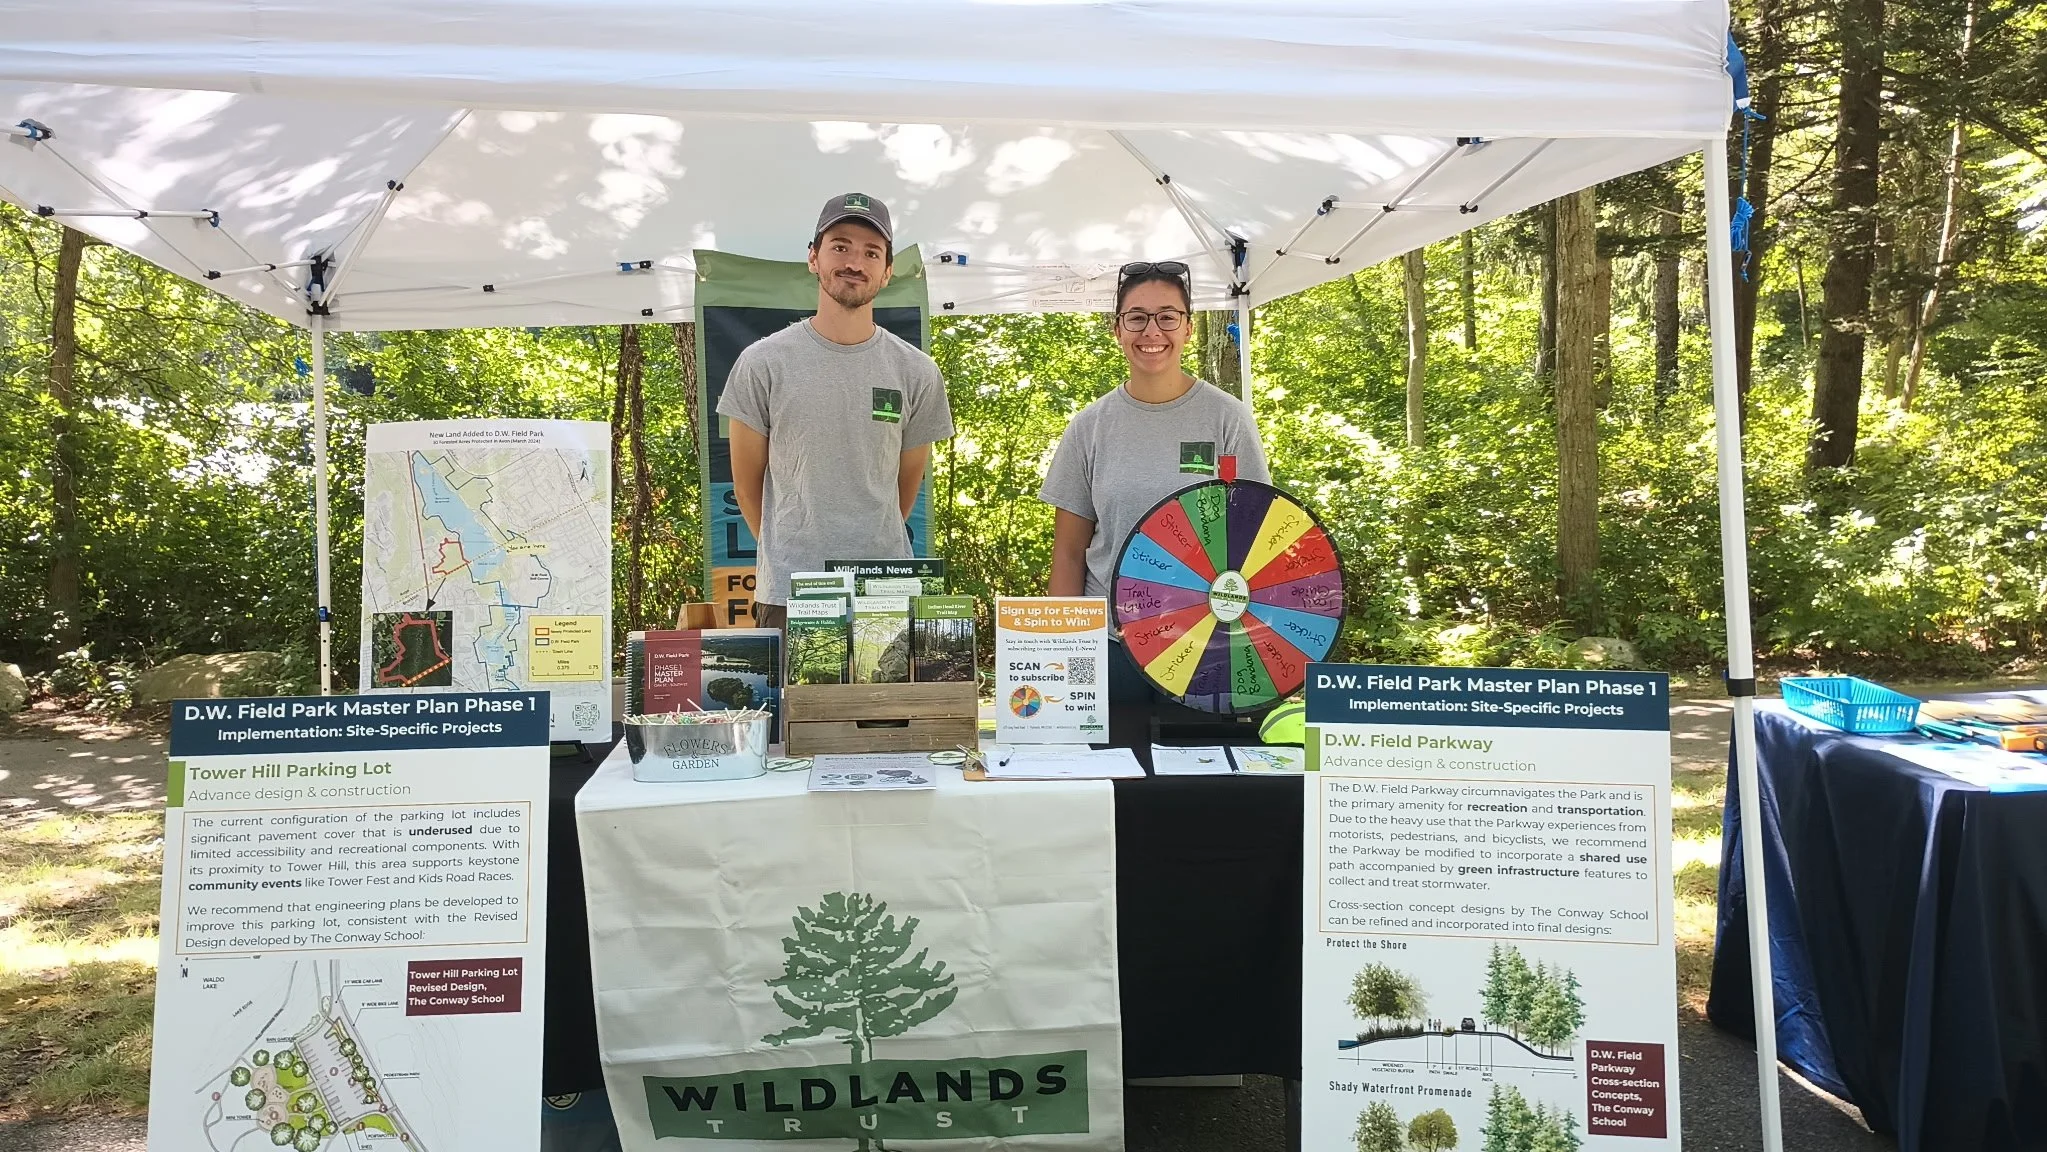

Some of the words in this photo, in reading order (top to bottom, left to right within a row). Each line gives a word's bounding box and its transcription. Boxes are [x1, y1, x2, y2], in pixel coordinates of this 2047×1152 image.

[1210, 494, 1220, 521] Dog
[1196, 499, 1211, 545] Bandana
[1161, 513, 1192, 549] Sticker
[1269, 514, 1299, 550] Sticker
[1132, 547, 1173, 571] Sticker
[1284, 548, 1325, 571] Sticker
[833, 566, 882, 575] Wildlands
[1122, 585, 1151, 597] Trail
[1213, 592, 1246, 600] WILDLANDS
[1291, 585, 1330, 597] Guide
[1001, 606, 1024, 616] Sign
[1028, 608, 1041, 616] up
[1044, 606, 1060, 614] for
[1063, 606, 1103, 614] E-News
[1123, 599, 1162, 613] Guide
[1303, 597, 1338, 612] Trail
[1024, 618, 1048, 627] Spin
[1050, 618, 1062, 626] to
[1065, 617, 1090, 626] Win!
[1135, 621, 1176, 646] Sticker
[1284, 621, 1326, 646] Sticker
[1009, 662, 1040, 670] SCAN
[1160, 640, 1195, 681] Sticker
[1264, 640, 1295, 678] Sticker
[1244, 645, 1260, 695] Bandana
[1237, 668, 1247, 695] Dog
[1317, 674, 1361, 689] D.W.
[1367, 674, 1411, 690] Field
[1418, 676, 1461, 691] Park
[1468, 677, 1532, 692] Master
[1538, 678, 1579, 693] Plan
[1586, 680, 1644, 695] Phase
[1649, 681, 1656, 695] 1
[1070, 692, 1095, 700] SPIN
[185, 705, 231, 720] D.W.
[238, 703, 285, 719] Field
[292, 701, 337, 717] Park
[343, 701, 410, 715] Master
[416, 698, 458, 713] Plan
[465, 697, 523, 712] Phase
[528, 697, 535, 710] 1
[1349, 698, 1467, 712] Implementation:
[1471, 700, 1560, 715] Site-Specific
[1564, 703, 1623, 717] Projects
[218, 725, 342, 742] Implementation:
[346, 722, 438, 738] Site-Specific
[442, 721, 502, 736] Projects
[663, 738, 728, 758] FLOWERS
[1325, 733, 1365, 746] D.W.
[1371, 733, 1411, 747] Field
[1418, 735, 1493, 753] Parkway
[189, 767, 246, 780] Tower
[252, 763, 280, 778] Hill
[287, 762, 356, 778] Parking
[363, 762, 391, 774] Lot
[672, 758, 719, 769] GARDEN
[1324, 755, 1383, 767] Advance
[1386, 757, 1432, 771] design
[1436, 758, 1445, 768] &
[1449, 760, 1535, 771] construction
[188, 789, 250, 801] Advance
[255, 787, 302, 801] design
[307, 786, 316, 797] &
[320, 783, 410, 797] construction
[192, 818, 213, 827] The
[220, 817, 263, 826] current
[270, 813, 347, 826] configuration
[355, 812, 367, 822] of
[374, 812, 392, 821] the
[400, 811, 443, 822] parking
[451, 810, 466, 818] lot
[473, 808, 520, 818] includes
[1329, 830, 1383, 841] motorists,
[1390, 831, 1457, 843] pedestrians,
[1464, 833, 1485, 842] and
[1492, 833, 1545, 845] bicyclists,
[1576, 838, 1646, 848] recommend
[1327, 937, 1359, 947] Protect
[1363, 939, 1376, 948] the
[1381, 939, 1406, 949] Shore
[409, 971, 440, 979] Tower
[443, 969, 458, 978] Hill
[461, 968, 499, 978] Parking
[409, 983, 447, 992] Revised
[450, 981, 487, 992] Design,
[408, 997, 427, 1005] The
[429, 997, 469, 1005] Conway
[471, 994, 504, 1003] School
[1591, 1050, 1615, 1059] D.W.
[1617, 1051, 1642, 1060] Field
[1591, 1063, 1635, 1075] Parkway
[662, 1064, 1068, 1113] WILDLANDS
[1329, 1080, 1358, 1094] Shady
[1362, 1082, 1413, 1094] Waterfront
[1418, 1085, 1471, 1097] Promenade
[1591, 1076, 1659, 1088] Cross-section
[1592, 1090, 1642, 1101] Concepts,
[1591, 1103, 1611, 1112] The
[1613, 1104, 1654, 1116] Conway
[1592, 1116, 1626, 1126] School
